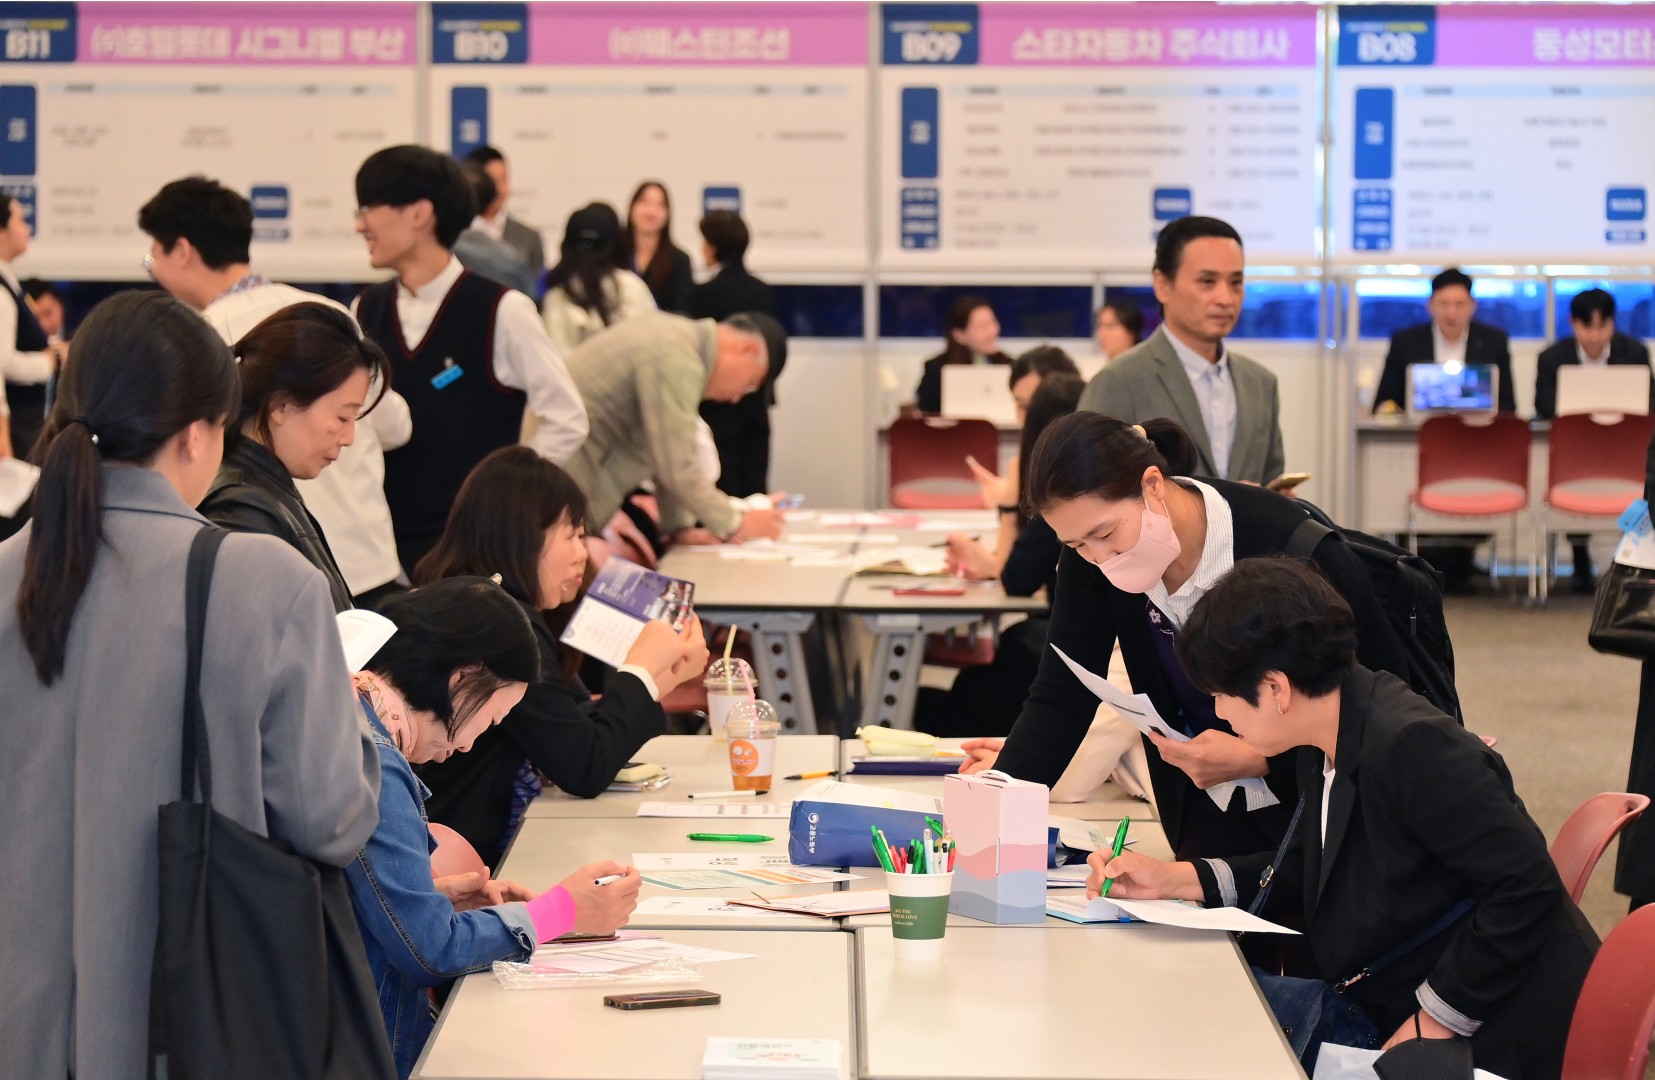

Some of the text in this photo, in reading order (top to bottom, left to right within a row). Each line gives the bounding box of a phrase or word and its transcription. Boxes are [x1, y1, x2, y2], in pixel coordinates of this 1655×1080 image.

[5, 30, 51, 59] B11
[350, 26, 405, 60] 부산
[454, 31, 508, 60] B10
[901, 32, 961, 62] B09
[1012, 28, 1290, 61] 스타자동차 주식회사
[1534, 27, 1655, 61] 동성모터
[808, 825, 817, 853] 고용노동부
